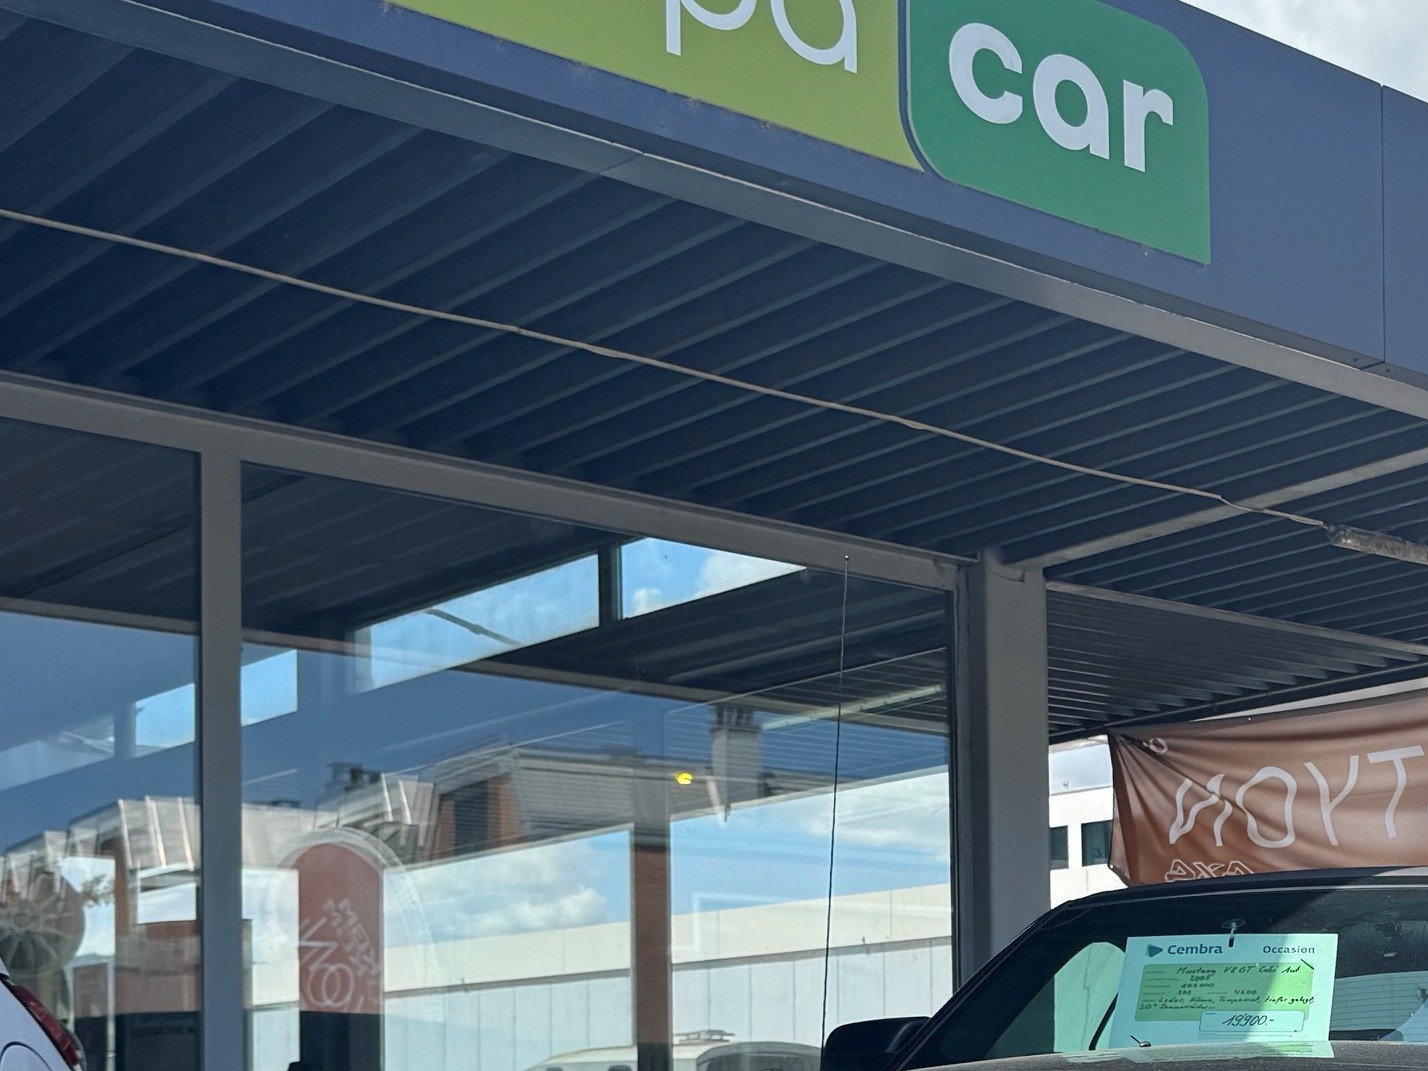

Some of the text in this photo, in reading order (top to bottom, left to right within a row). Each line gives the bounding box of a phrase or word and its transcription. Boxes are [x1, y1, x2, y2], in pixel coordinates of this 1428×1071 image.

[948, 22, 1174, 173] car
[1167, 943, 1223, 955] Cembra
[1262, 945, 1315, 954] Occasion
